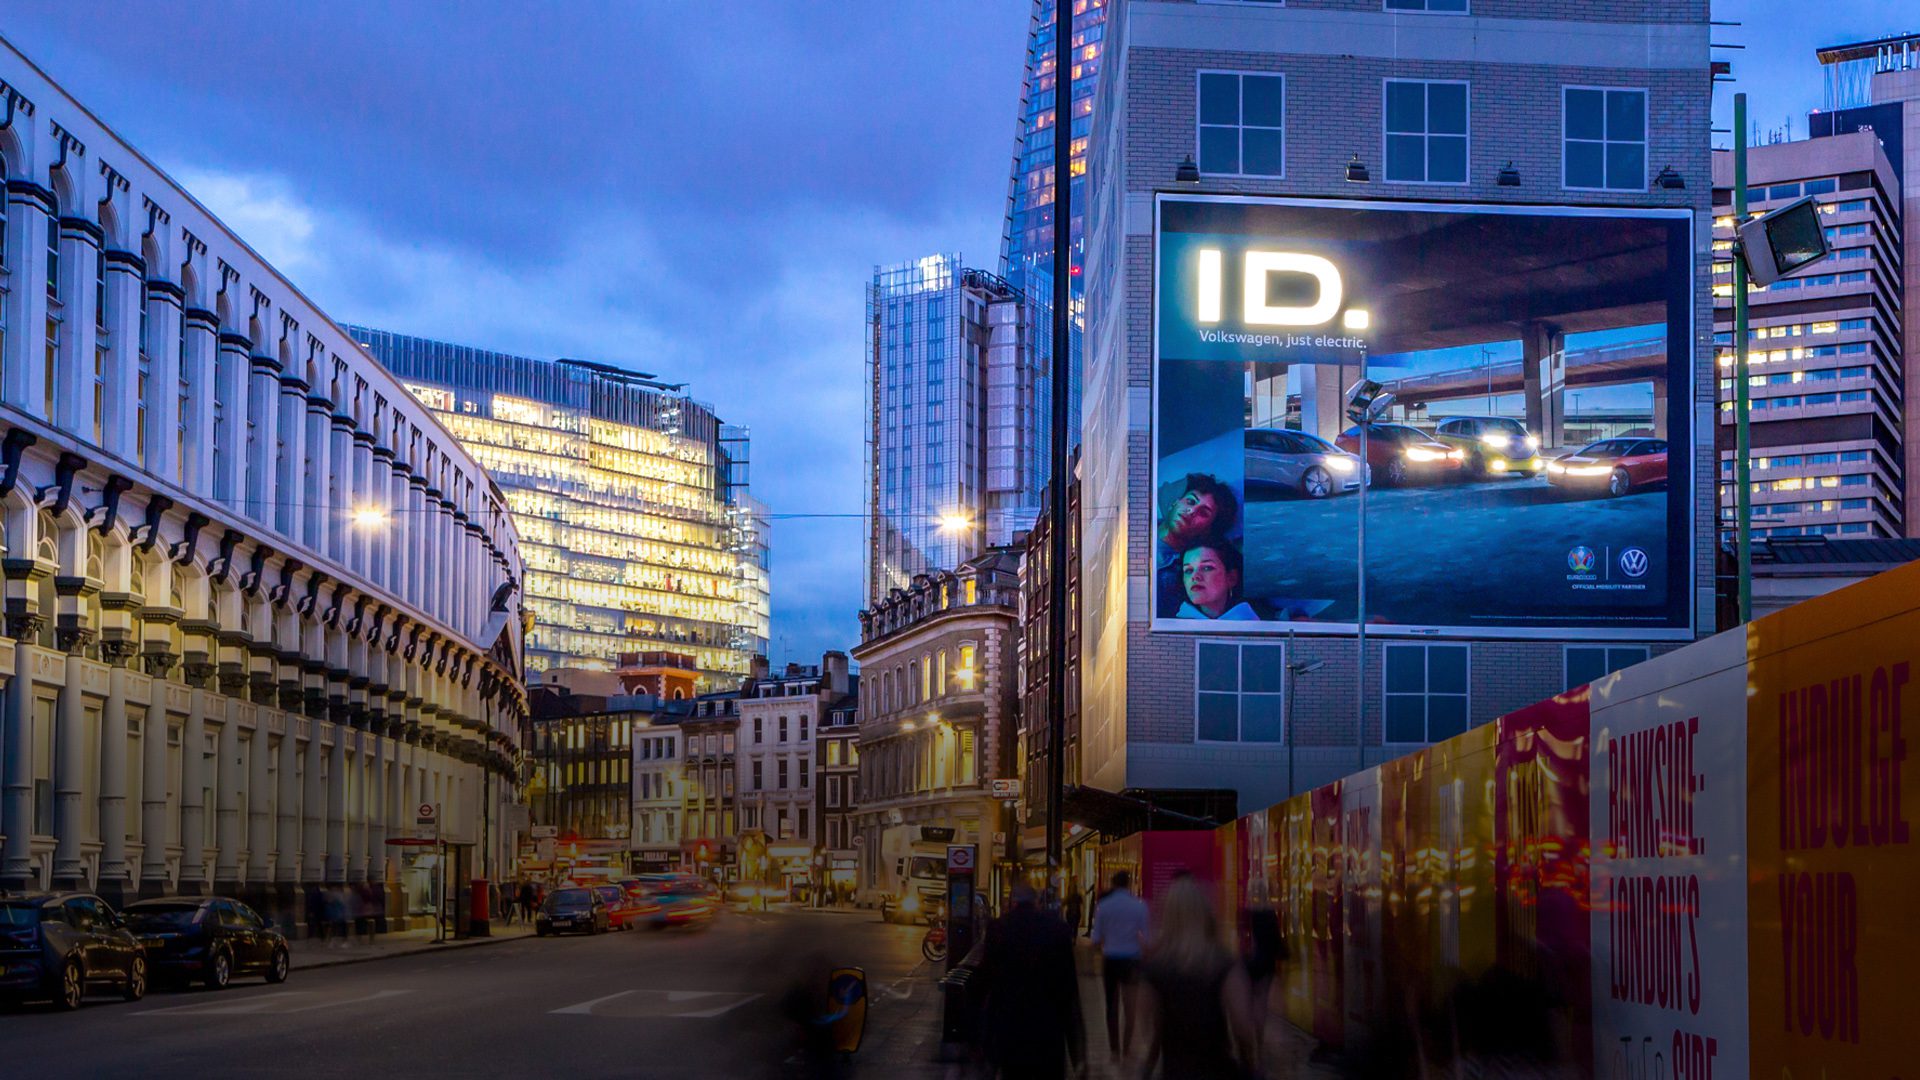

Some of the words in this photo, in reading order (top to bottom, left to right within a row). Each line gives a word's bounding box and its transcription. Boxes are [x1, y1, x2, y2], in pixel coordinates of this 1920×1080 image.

[1198, 249, 1369, 329] ID.
[1199, 329, 1283, 347] Volkswagen,
[1286, 333, 1311, 348] just
[1315, 334, 1367, 349] electric.
[1608, 716, 1705, 859] BANKSIDE:
[1779, 660, 1910, 851] INDULGE
[1609, 874, 1701, 1016] LONDON'S
[1778, 871, 1860, 1045] YOUR
